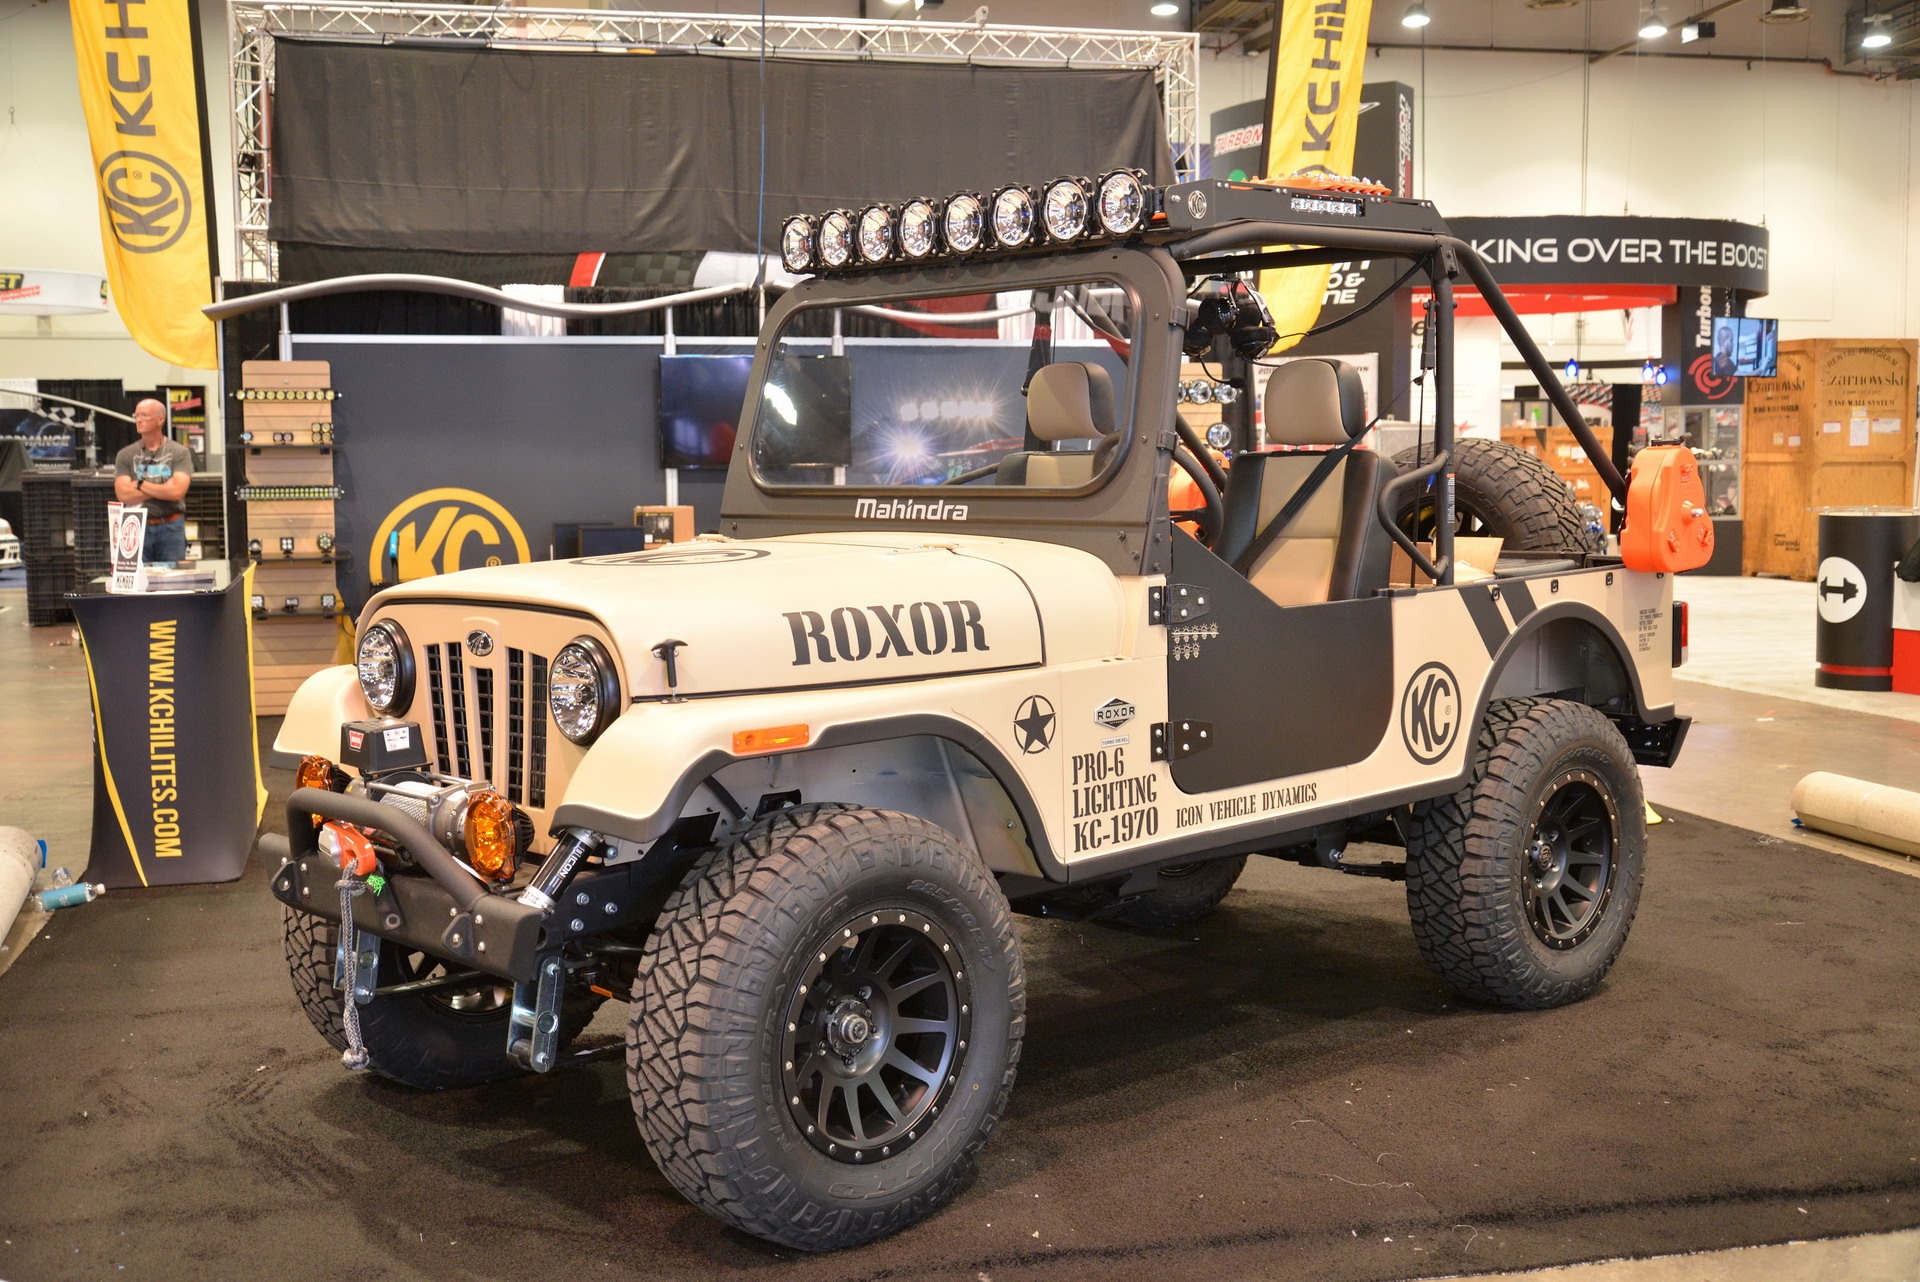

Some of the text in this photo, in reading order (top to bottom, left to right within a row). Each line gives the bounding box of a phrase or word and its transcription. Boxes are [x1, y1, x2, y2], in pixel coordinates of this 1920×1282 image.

[1567, 238, 1663, 264] OVER
[1669, 239, 1717, 265] THE
[1721, 243, 1768, 271] BOOST
[1858, 347, 1898, 368] PROGRAM
[854, 498, 969, 520] Mahindra
[782, 600, 990, 667] ROXOR
[1097, 706, 1136, 720] ROXOR
[1411, 673, 1451, 752] KC
[149, 619, 183, 858] WWW.KCHILITES.COM
[1072, 747, 1124, 786] PRO-6
[1072, 773, 1158, 819] LIGHTING
[1176, 783, 1318, 829] ICON VEHICLE DYNAMICS
[1073, 806, 1159, 853] KC-1970
[560, 855, 578, 878] ICON
